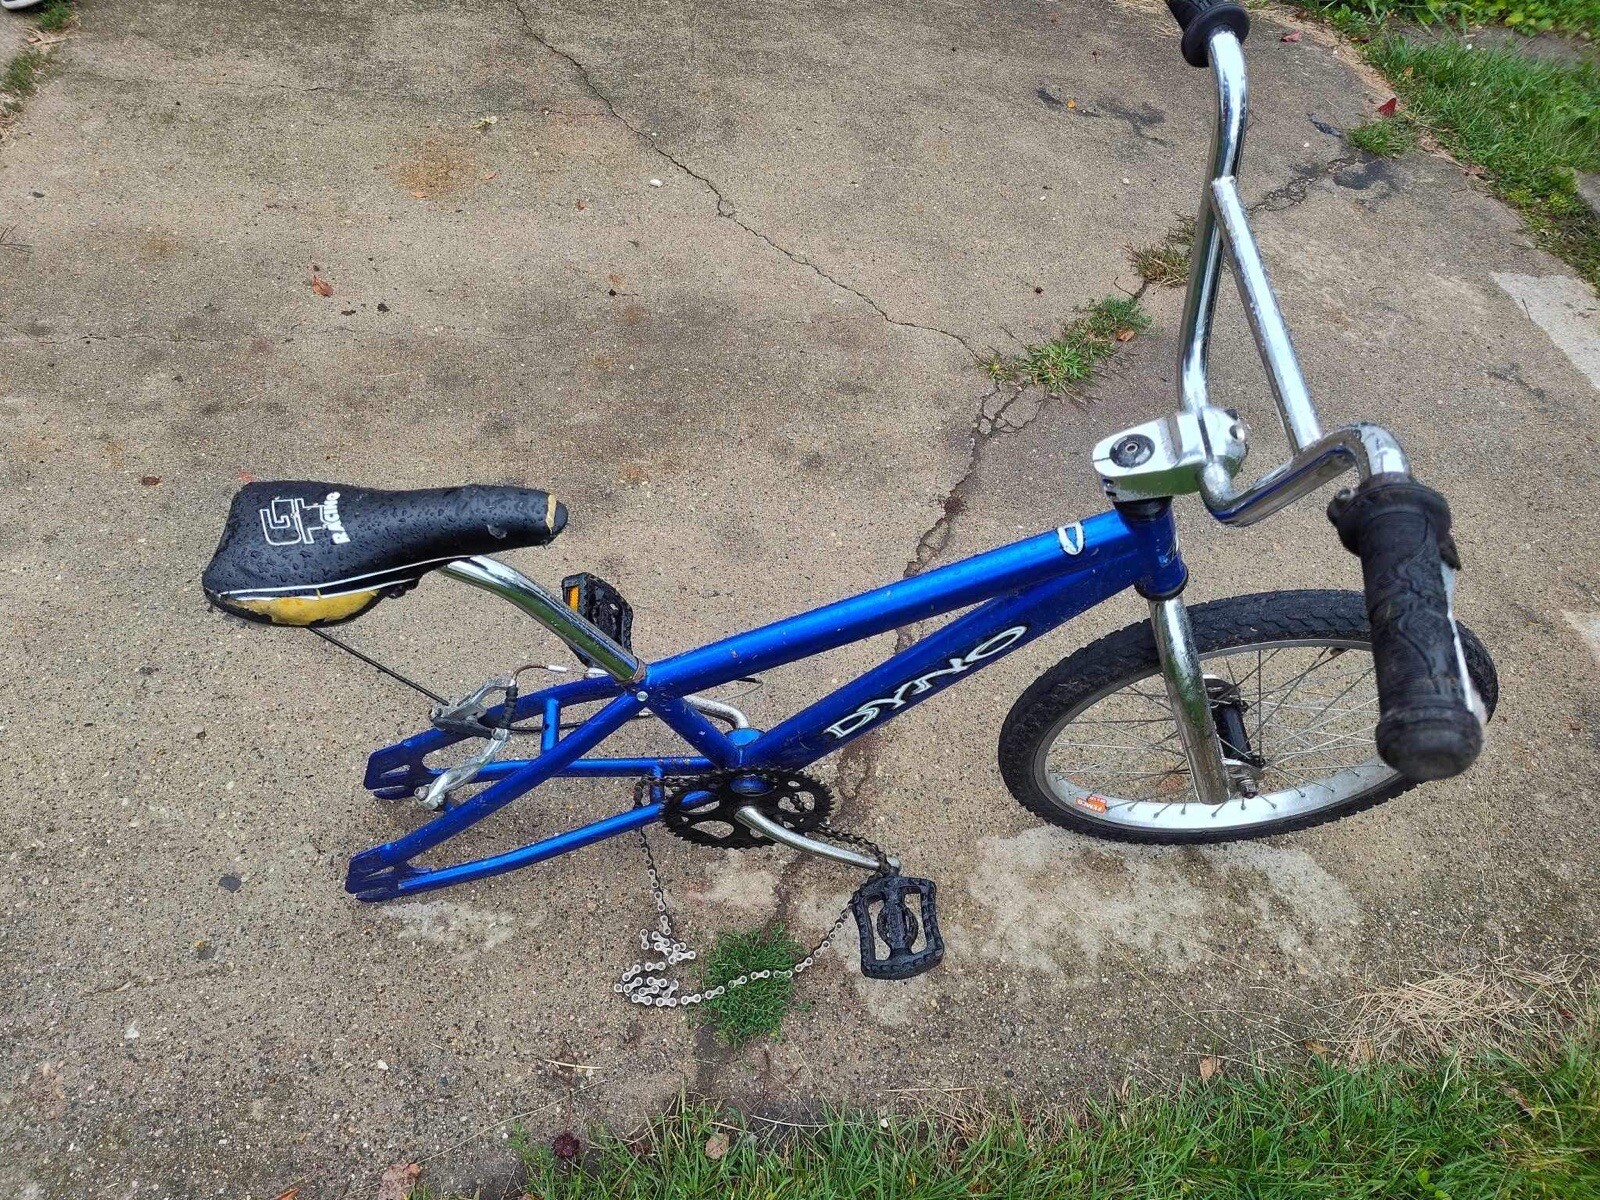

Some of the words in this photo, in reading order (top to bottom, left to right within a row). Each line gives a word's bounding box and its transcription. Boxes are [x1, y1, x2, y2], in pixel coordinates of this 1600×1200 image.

[259, 497, 328, 545] GT
[325, 491, 351, 545] RACING
[823, 625, 1028, 739] DYNO
